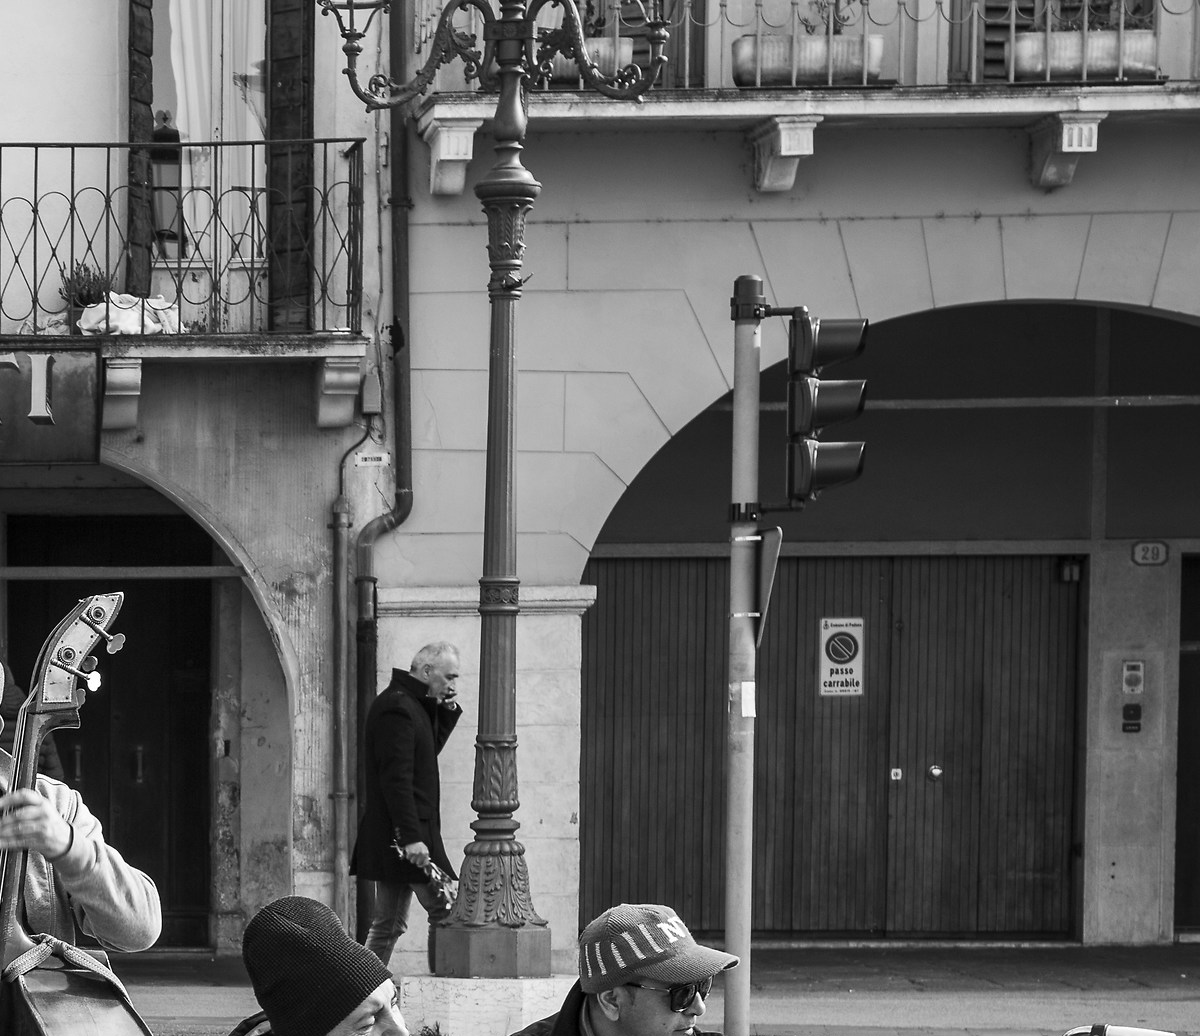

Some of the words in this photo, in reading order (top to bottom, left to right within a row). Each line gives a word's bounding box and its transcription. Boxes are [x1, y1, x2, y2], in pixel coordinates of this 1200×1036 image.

[1141, 545, 1160, 561] 29
[830, 667, 854, 677] passo
[823, 678, 860, 688] carrabile
